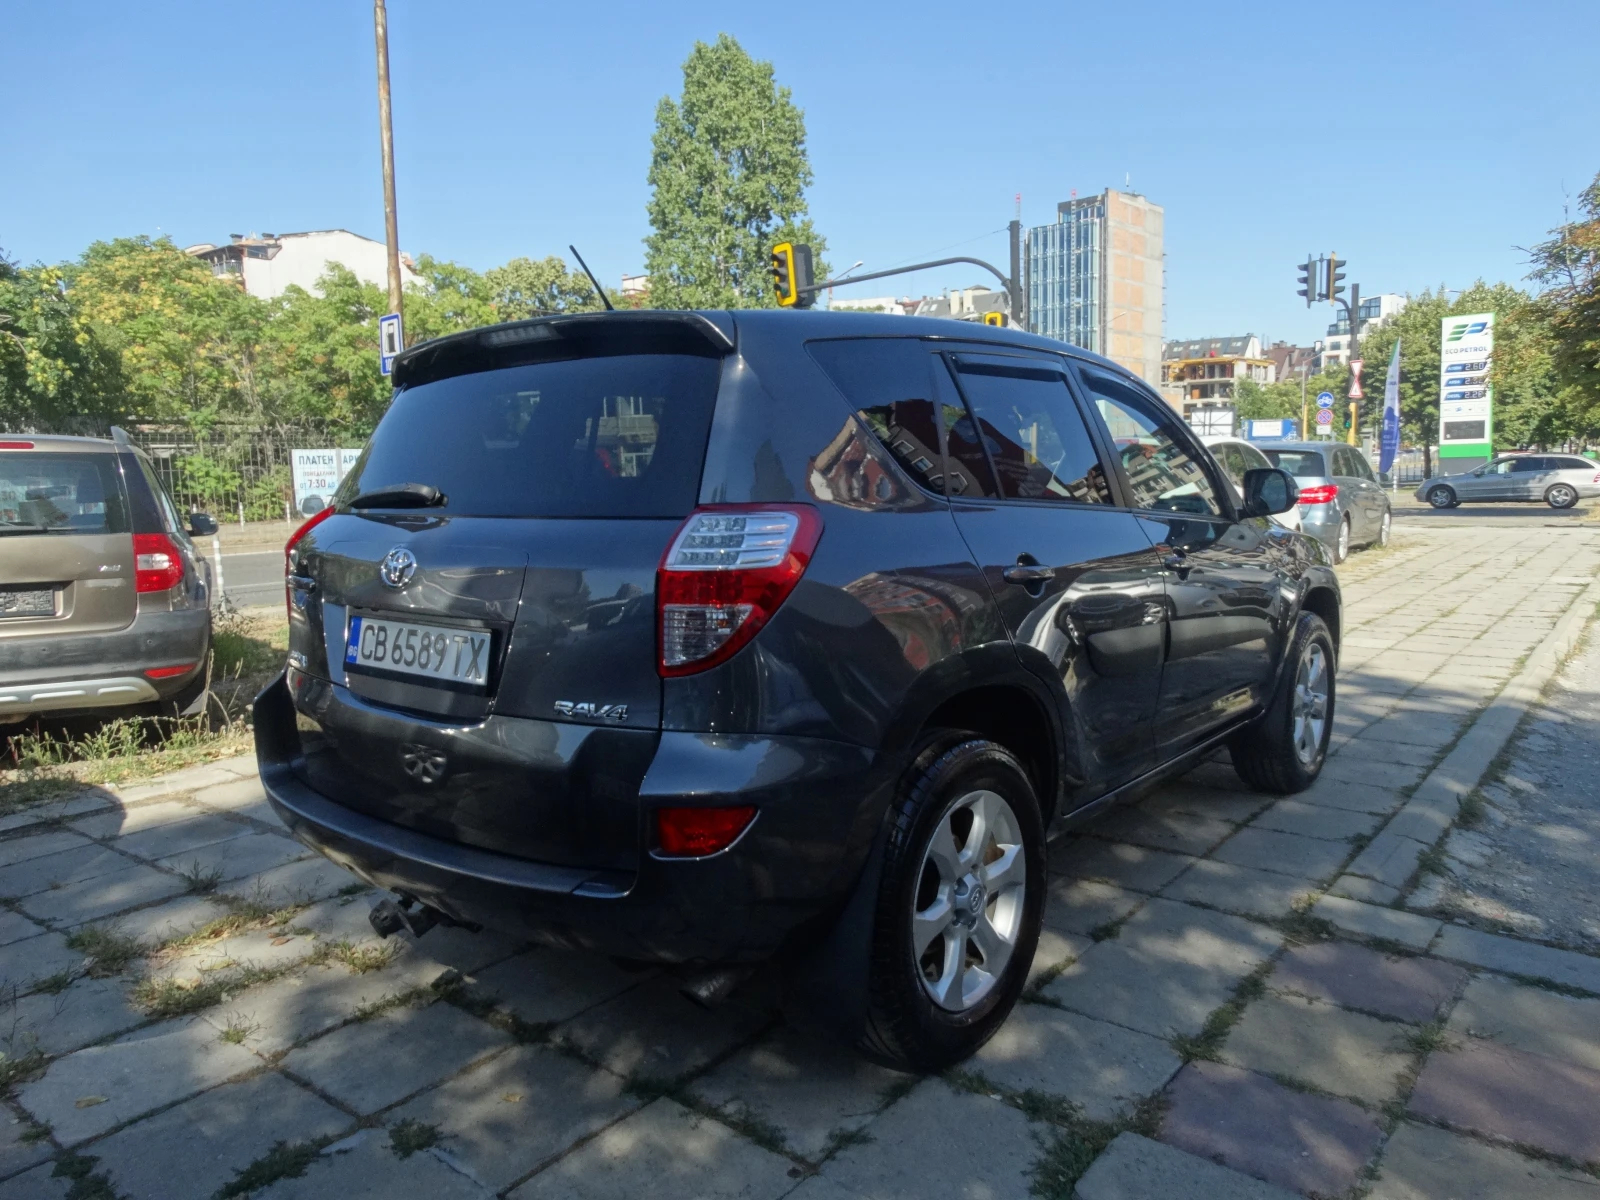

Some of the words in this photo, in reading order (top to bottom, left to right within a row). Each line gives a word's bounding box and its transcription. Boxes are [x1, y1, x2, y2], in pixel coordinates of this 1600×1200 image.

[1465, 362, 1484, 370] 2.60
[298, 455, 334, 465] ПЛАТЕН
[307, 479, 326, 488] 7:30
[361, 624, 388, 662] CB
[391, 627, 449, 672] 6589
[452, 634, 486, 679] TX
[553, 700, 629, 720] RAV4
